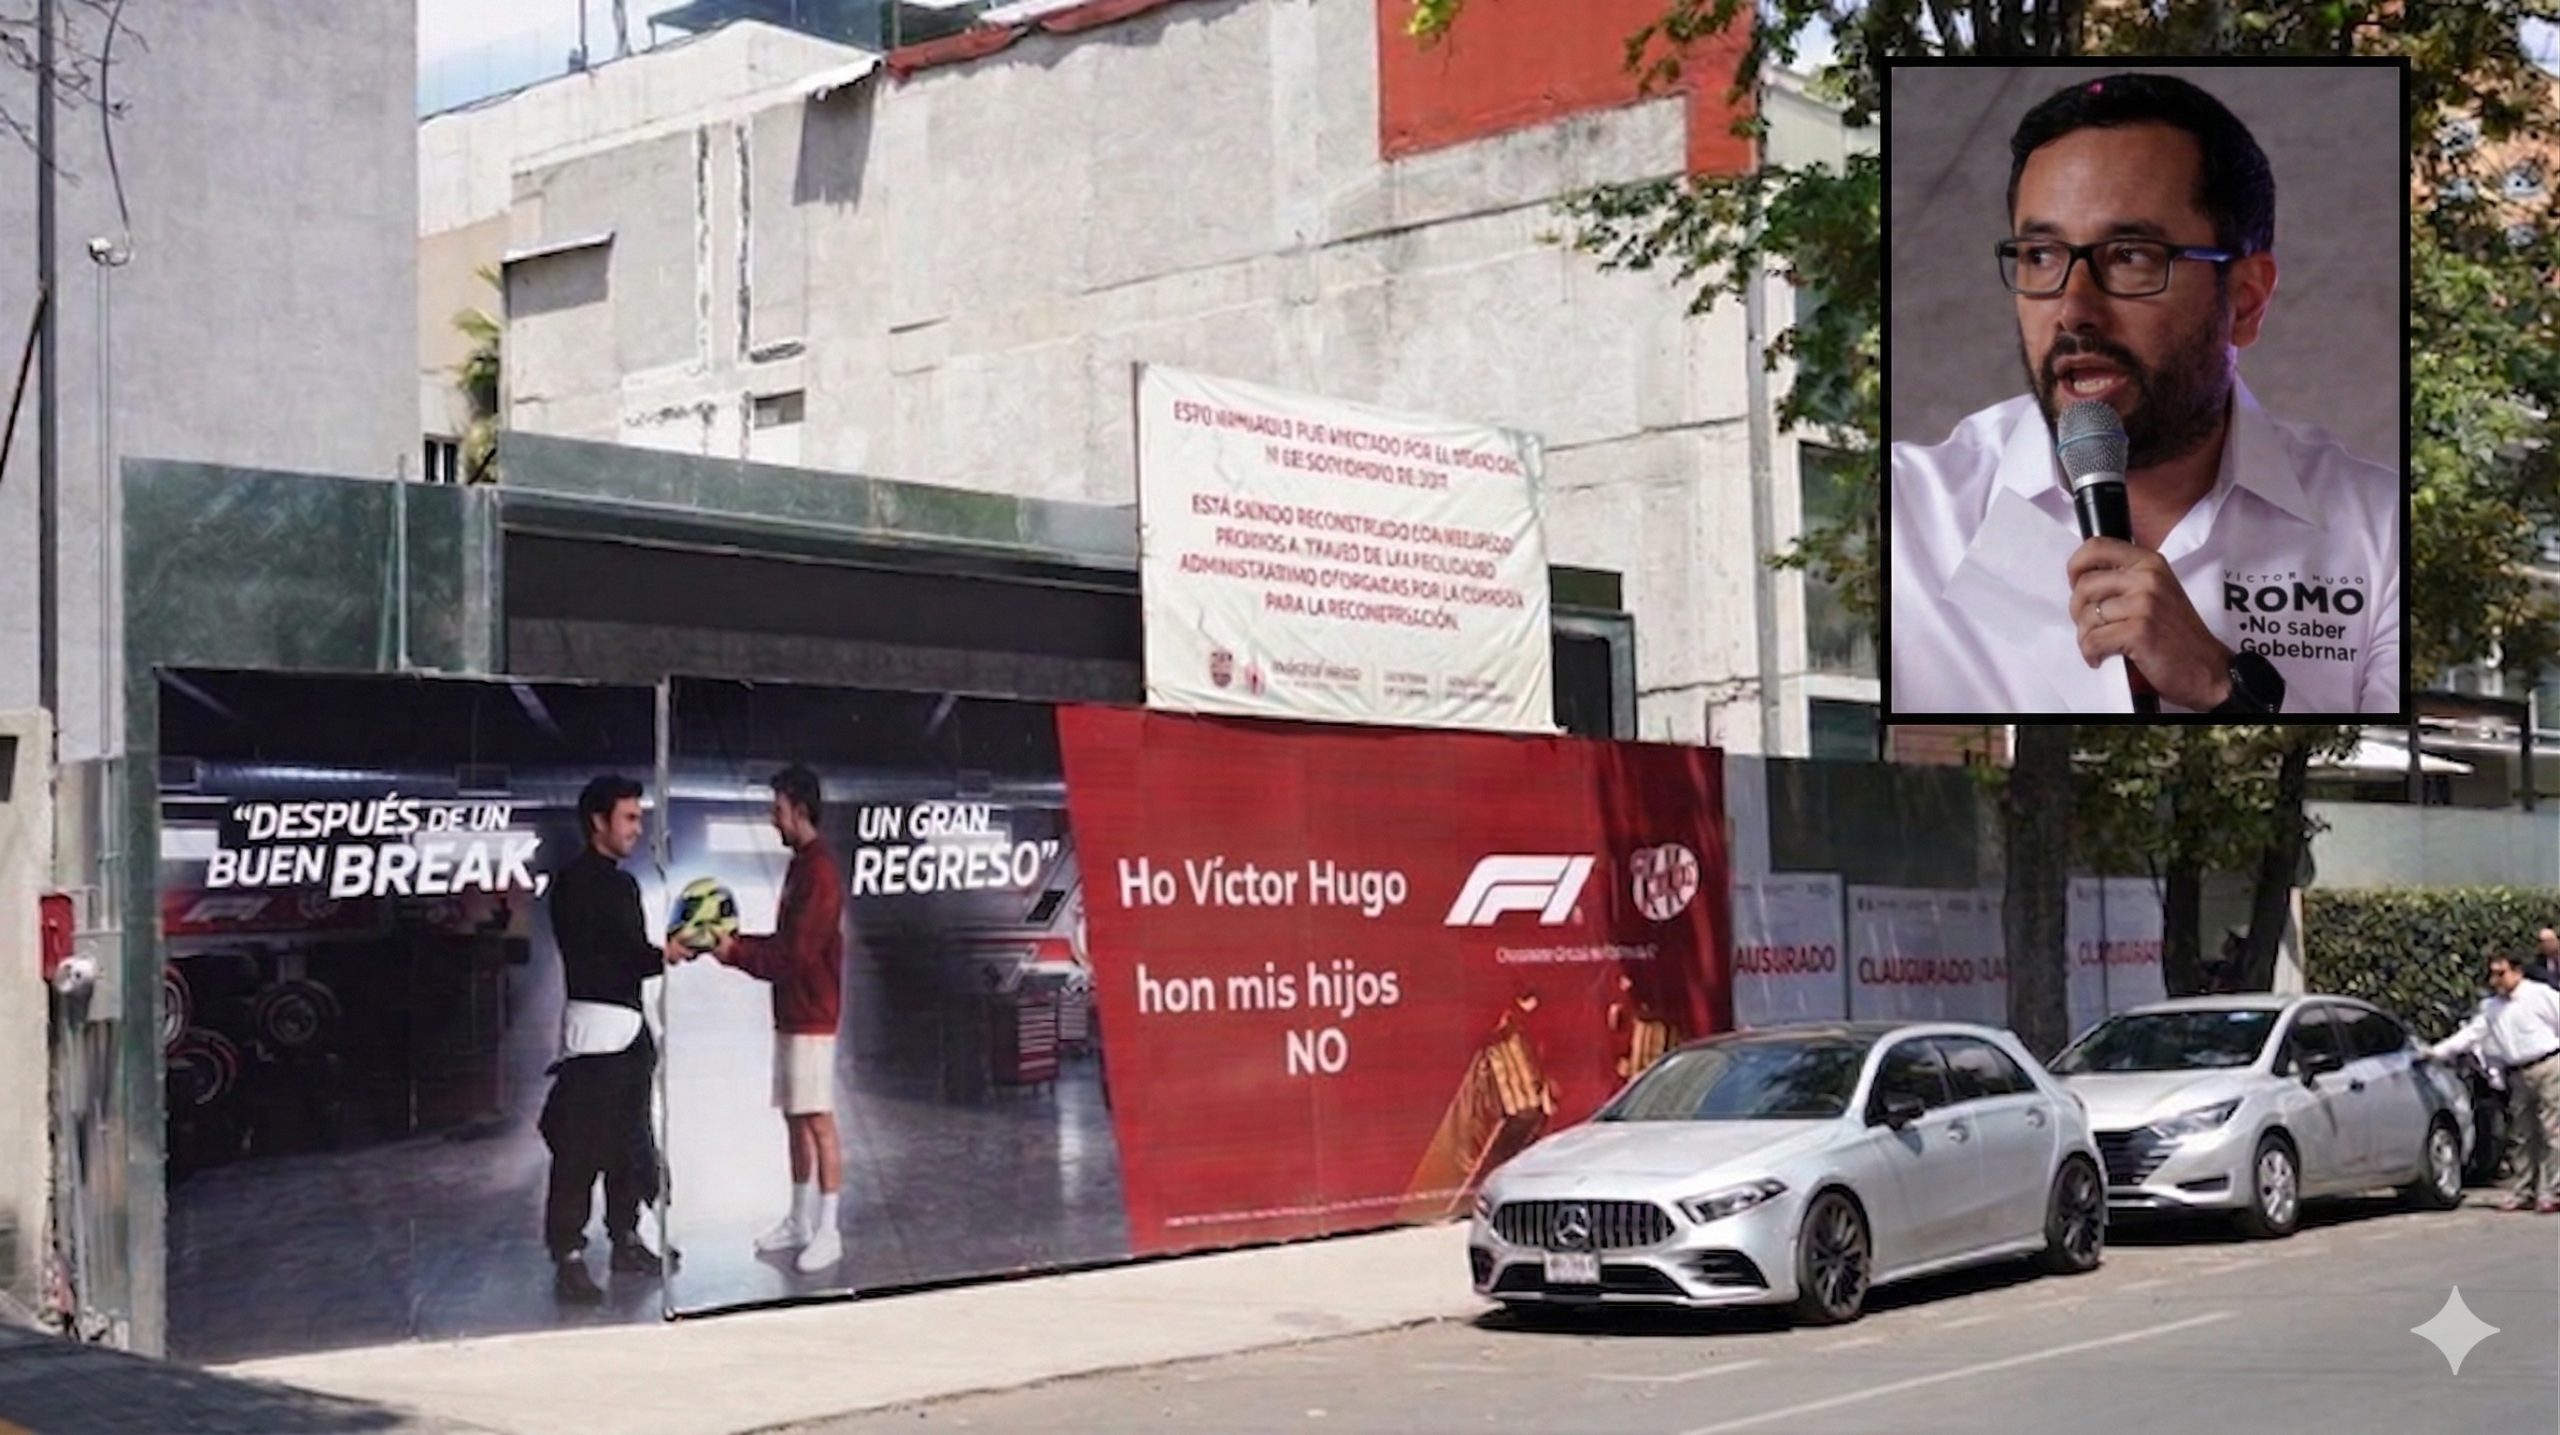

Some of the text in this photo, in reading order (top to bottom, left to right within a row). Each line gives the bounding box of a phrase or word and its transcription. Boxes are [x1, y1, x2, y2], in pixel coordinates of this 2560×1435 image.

[2312, 574, 2364, 585] HUGO
[2224, 581, 2364, 615] ROMO
[2288, 620, 2346, 639] saber
[427, 806, 463, 832] DE
[470, 806, 510, 831] UN
[857, 804, 989, 840] UN GRAN
[206, 836, 550, 899] BUEN BREAK,
[1118, 856, 1406, 917] Ho Víctor Hugo
[1136, 958, 1400, 1018] hon mis hijos
[1286, 1027, 1347, 1075] NO
